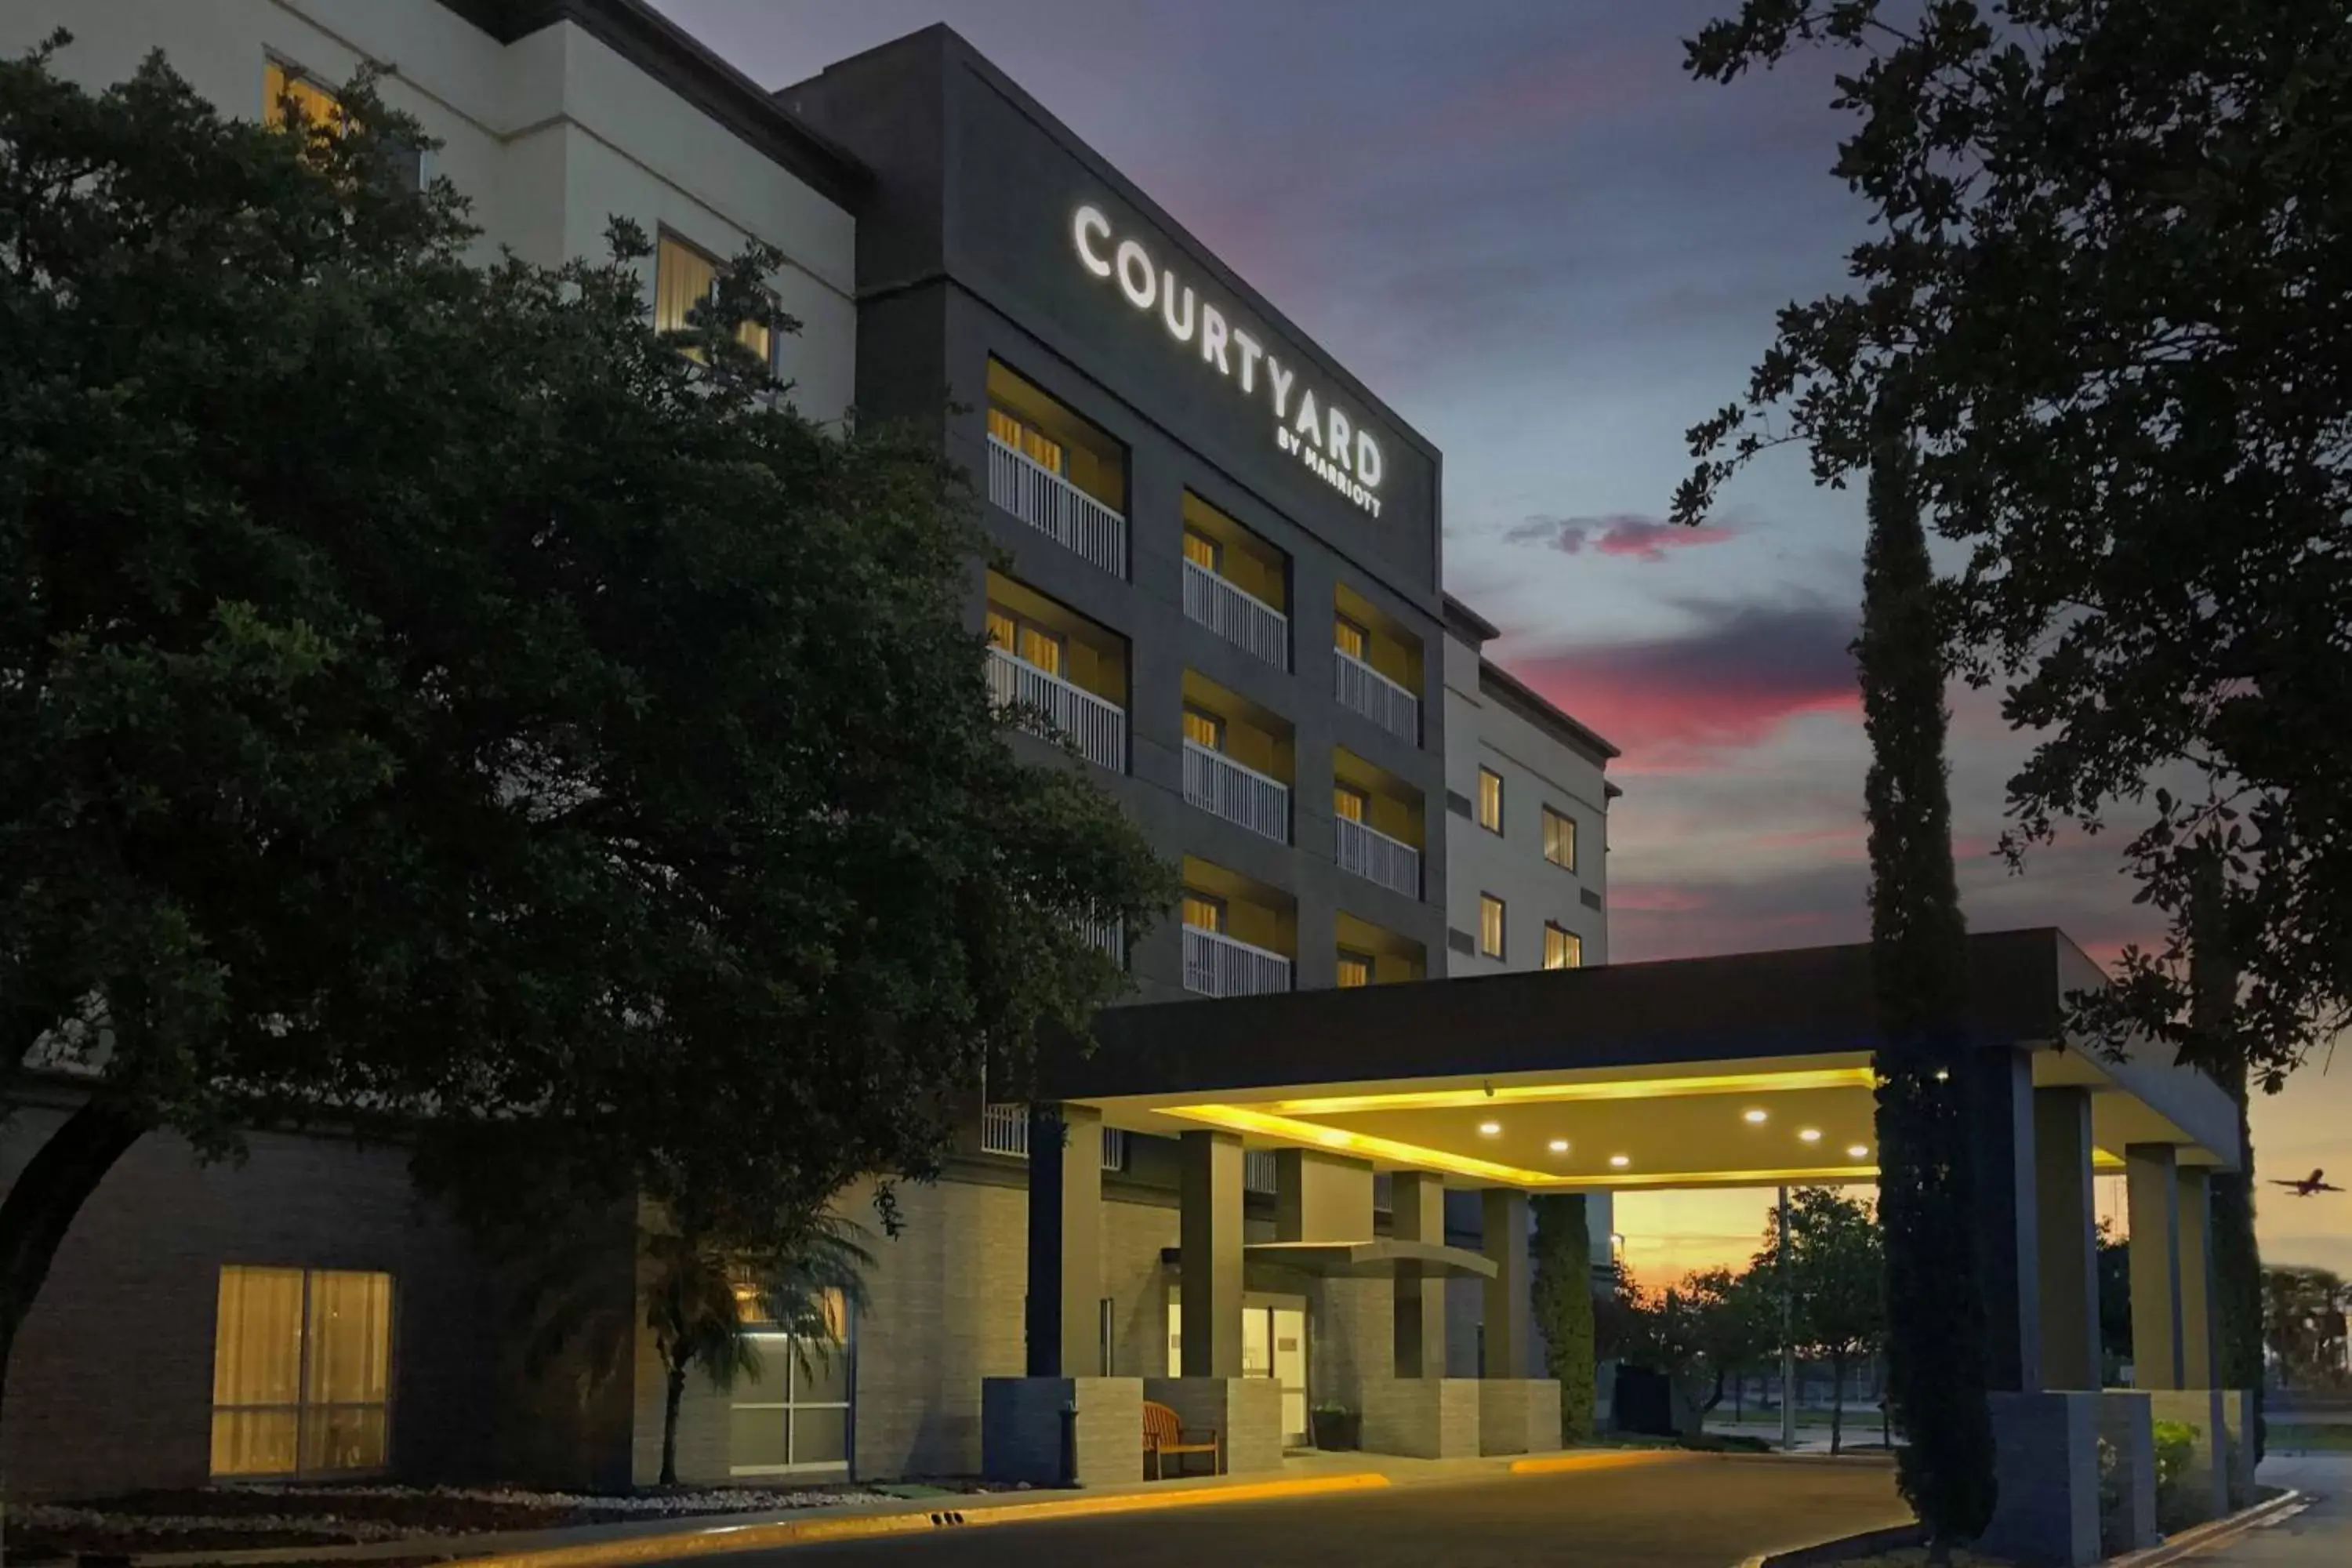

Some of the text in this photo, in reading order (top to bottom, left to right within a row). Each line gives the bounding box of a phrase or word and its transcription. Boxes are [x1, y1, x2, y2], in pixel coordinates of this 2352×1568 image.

[1074, 205, 1382, 488] COURTYARD
[1277, 425, 1381, 518] BY MARRIOTT
